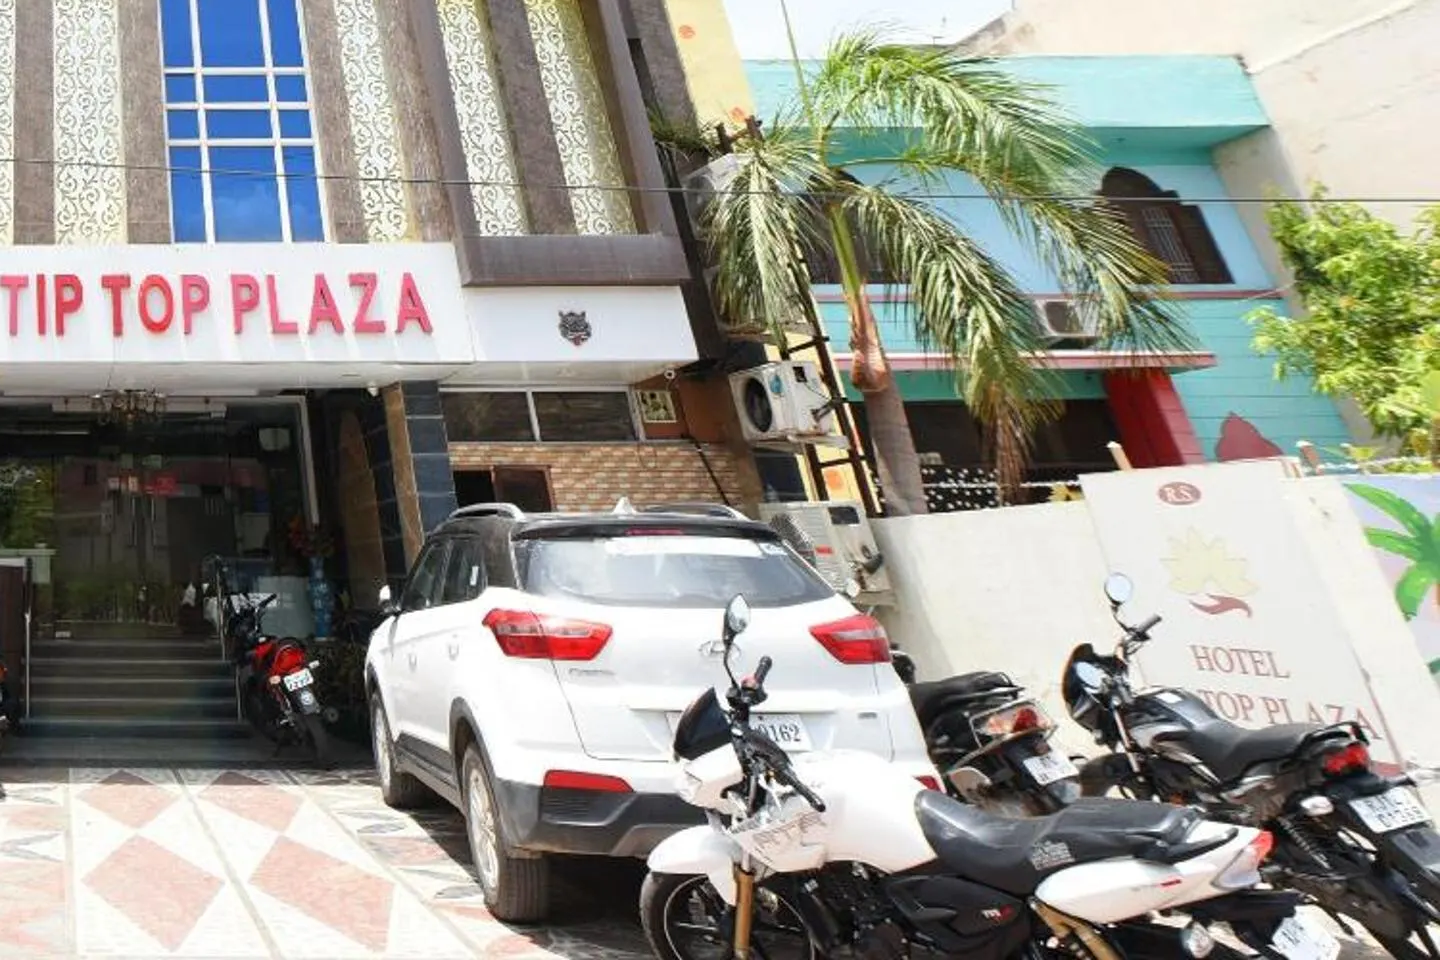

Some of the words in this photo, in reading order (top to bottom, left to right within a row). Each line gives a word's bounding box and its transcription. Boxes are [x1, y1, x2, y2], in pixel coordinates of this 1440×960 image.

[0, 274, 84, 337] TIP
[102, 273, 211, 336] TOP
[230, 271, 434, 336] PLAZA
[1190, 644, 1290, 679] HOTEL
[1197, 689, 1254, 721] TOP
